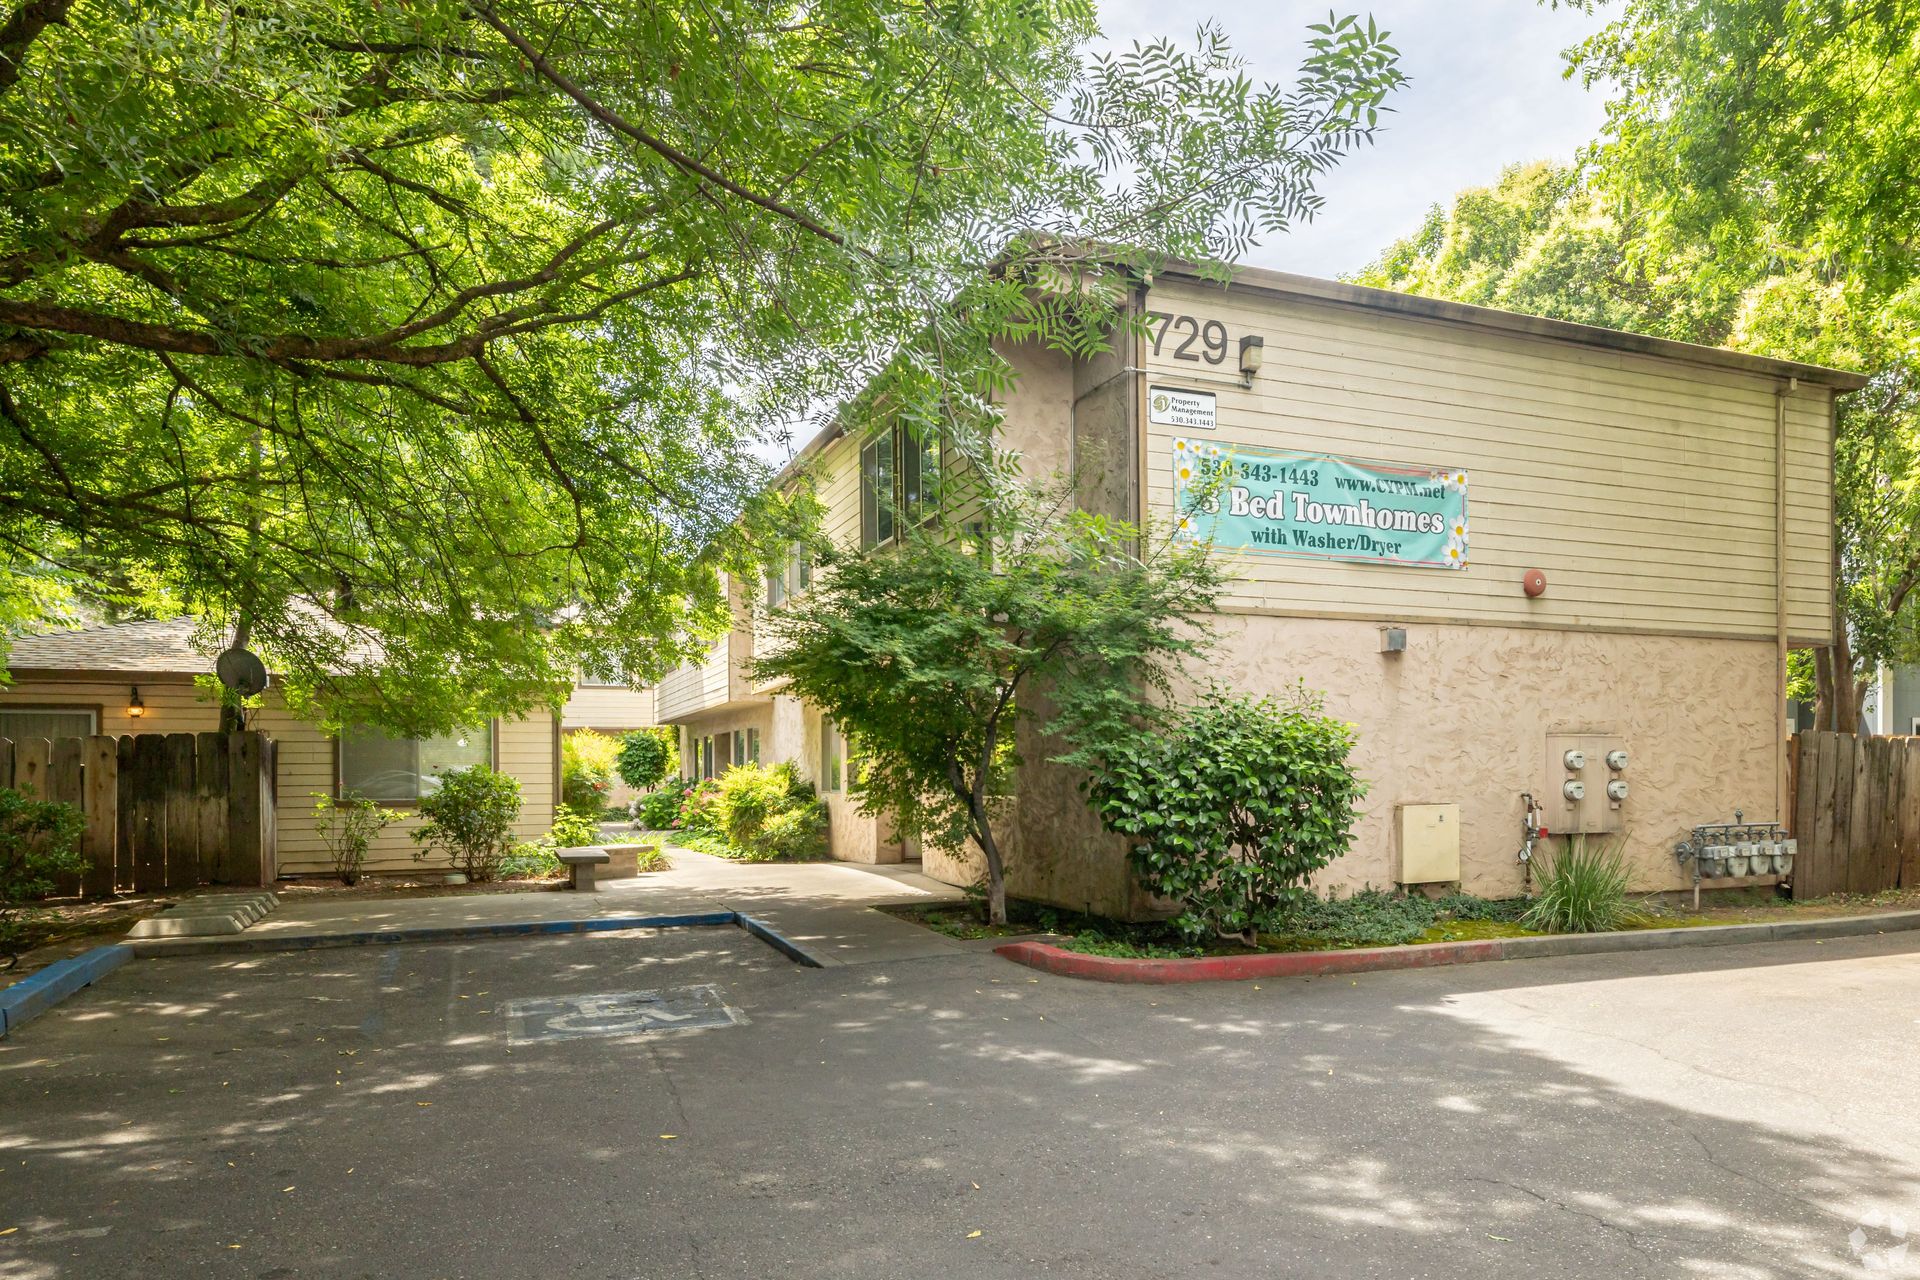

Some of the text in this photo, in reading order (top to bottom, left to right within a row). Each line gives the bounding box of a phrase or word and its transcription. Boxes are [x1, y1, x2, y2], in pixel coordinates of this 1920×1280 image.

[1149, 311, 1227, 365] 729
[1171, 397, 1200, 408] Property
[1171, 406, 1214, 416] Management
[1171, 416, 1214, 427] 530.343.1443
[1201, 458, 1445, 499] 530-343-1443 www.CYPM.net
[1229, 486, 1285, 520] Bed
[1292, 491, 1445, 534] Townhomes
[1251, 527, 1402, 557] with Washer/Dryer
